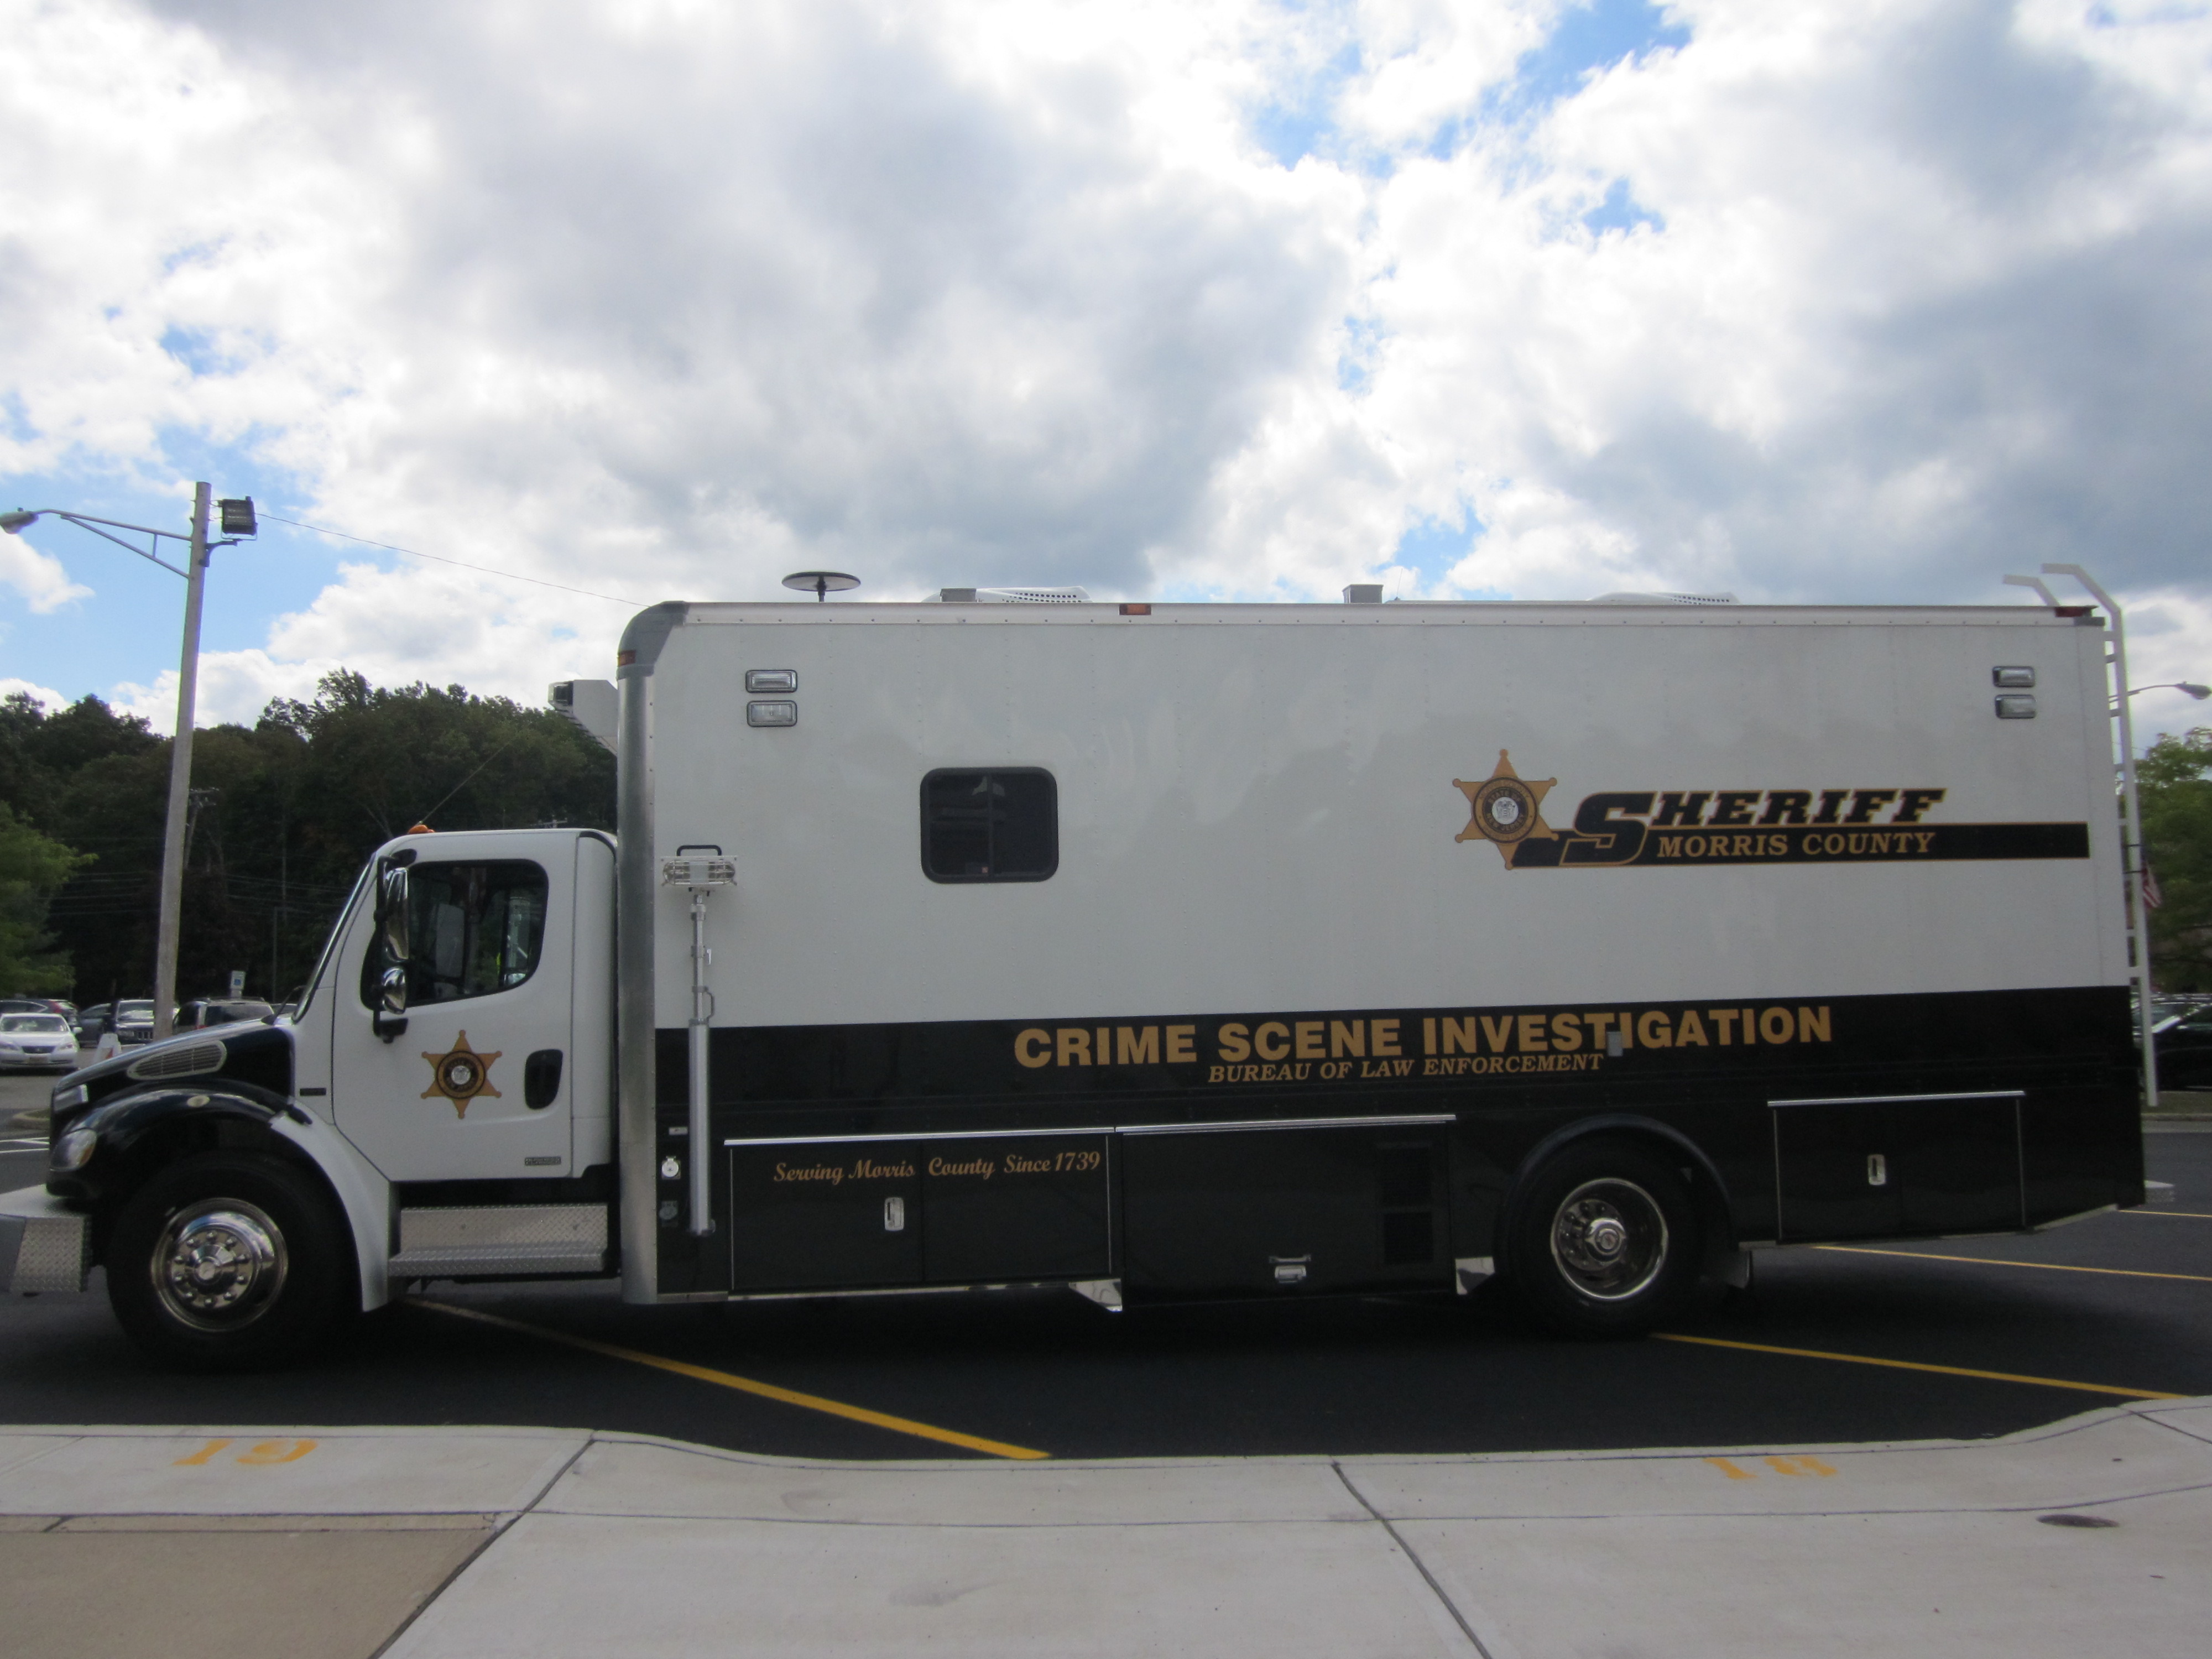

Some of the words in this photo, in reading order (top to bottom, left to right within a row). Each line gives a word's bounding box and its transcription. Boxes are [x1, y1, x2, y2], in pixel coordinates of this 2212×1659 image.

[1559, 788, 1947, 866] SHERIFF
[1657, 834, 1788, 858] MORRIS
[1802, 832, 1936, 855] COUNTY
[1014, 1025, 1197, 1068] CRIME
[1217, 1019, 1402, 1062] SCENE
[1424, 1006, 1832, 1056] INVESTIGATION
[1208, 1063, 1311, 1083] BUREAU
[1320, 1062, 1353, 1079] OF
[1360, 1059, 1415, 1077] LAW
[1423, 1053, 1605, 1075] ENFORCEMENT
[774, 1162, 845, 1186] Serving
[848, 1159, 916, 1180] Morris
[928, 1157, 995, 1180] County
[1004, 1154, 1051, 1173] Since
[1055, 1151, 1102, 1171] 1739
